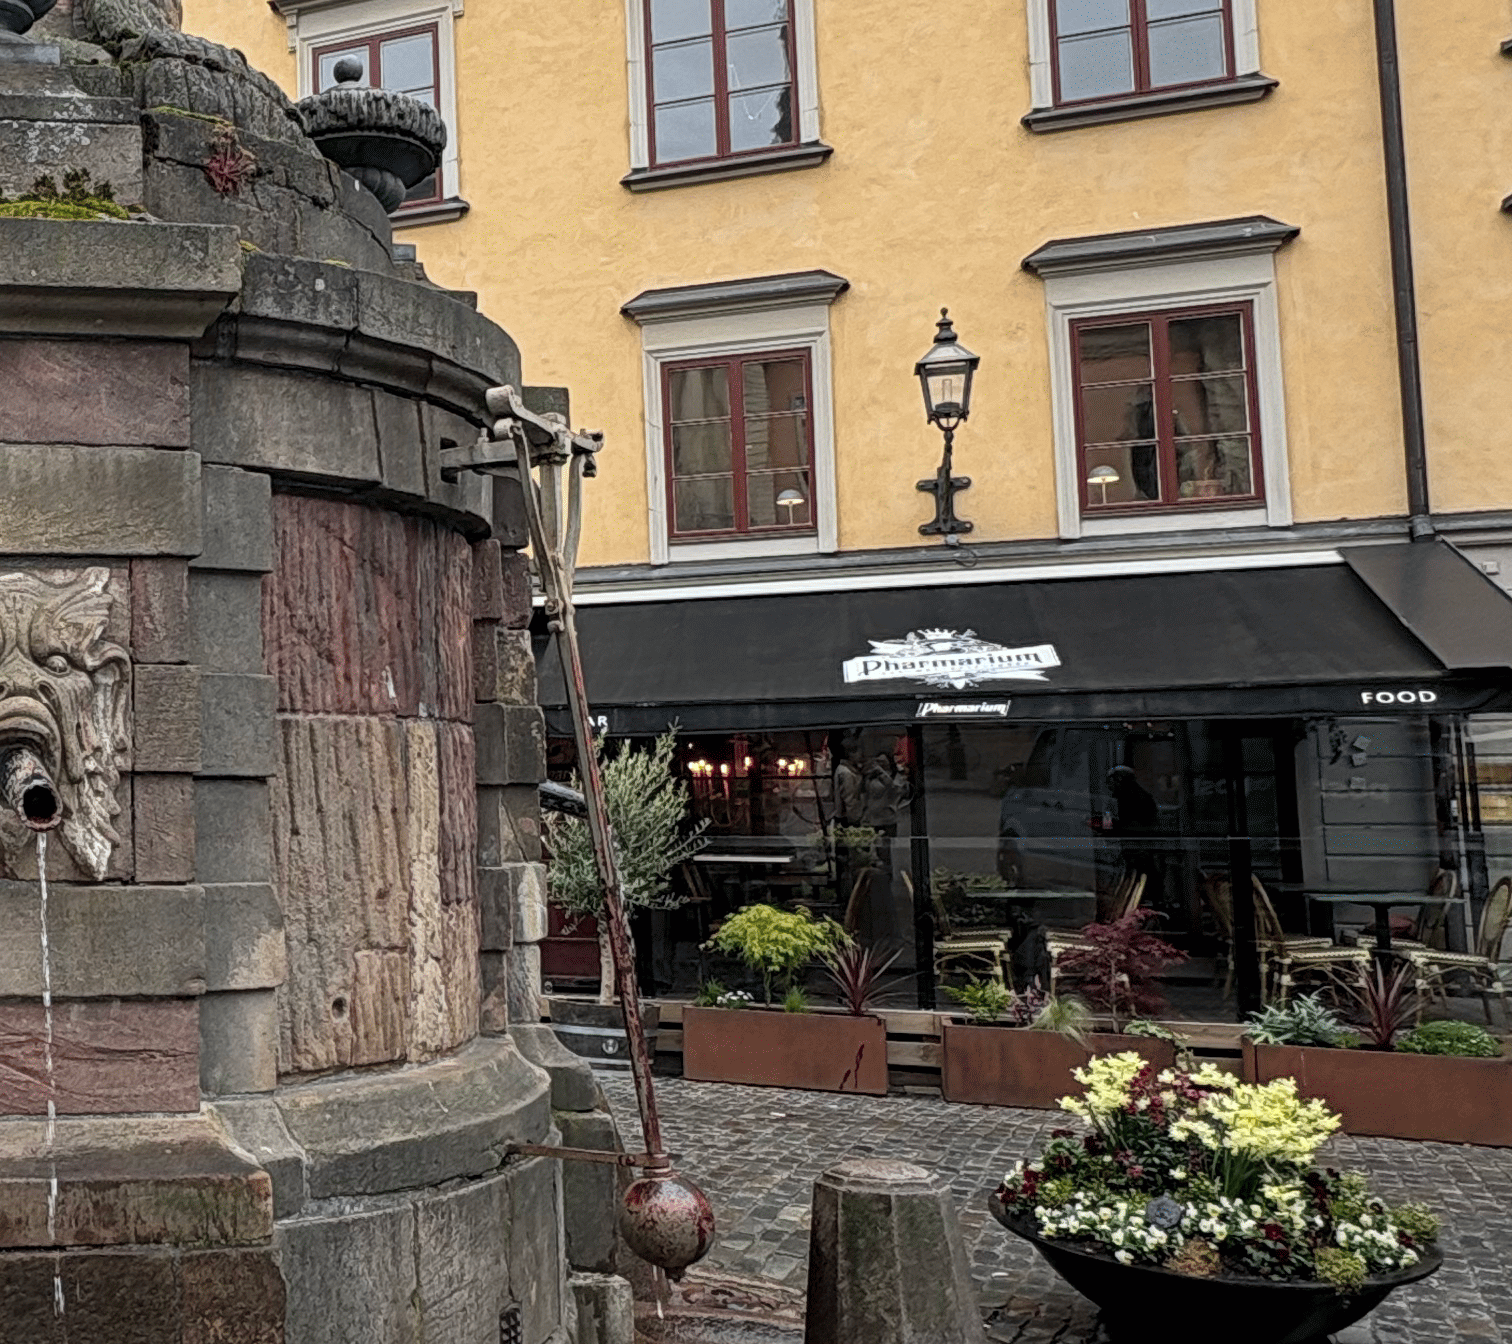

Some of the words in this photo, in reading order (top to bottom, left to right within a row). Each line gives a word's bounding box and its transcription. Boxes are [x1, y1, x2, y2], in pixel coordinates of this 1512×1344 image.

[858, 652, 1043, 676] Pharmarium
[1360, 690, 1437, 704] FOOD
[921, 701, 1007, 716] Pharmarium
